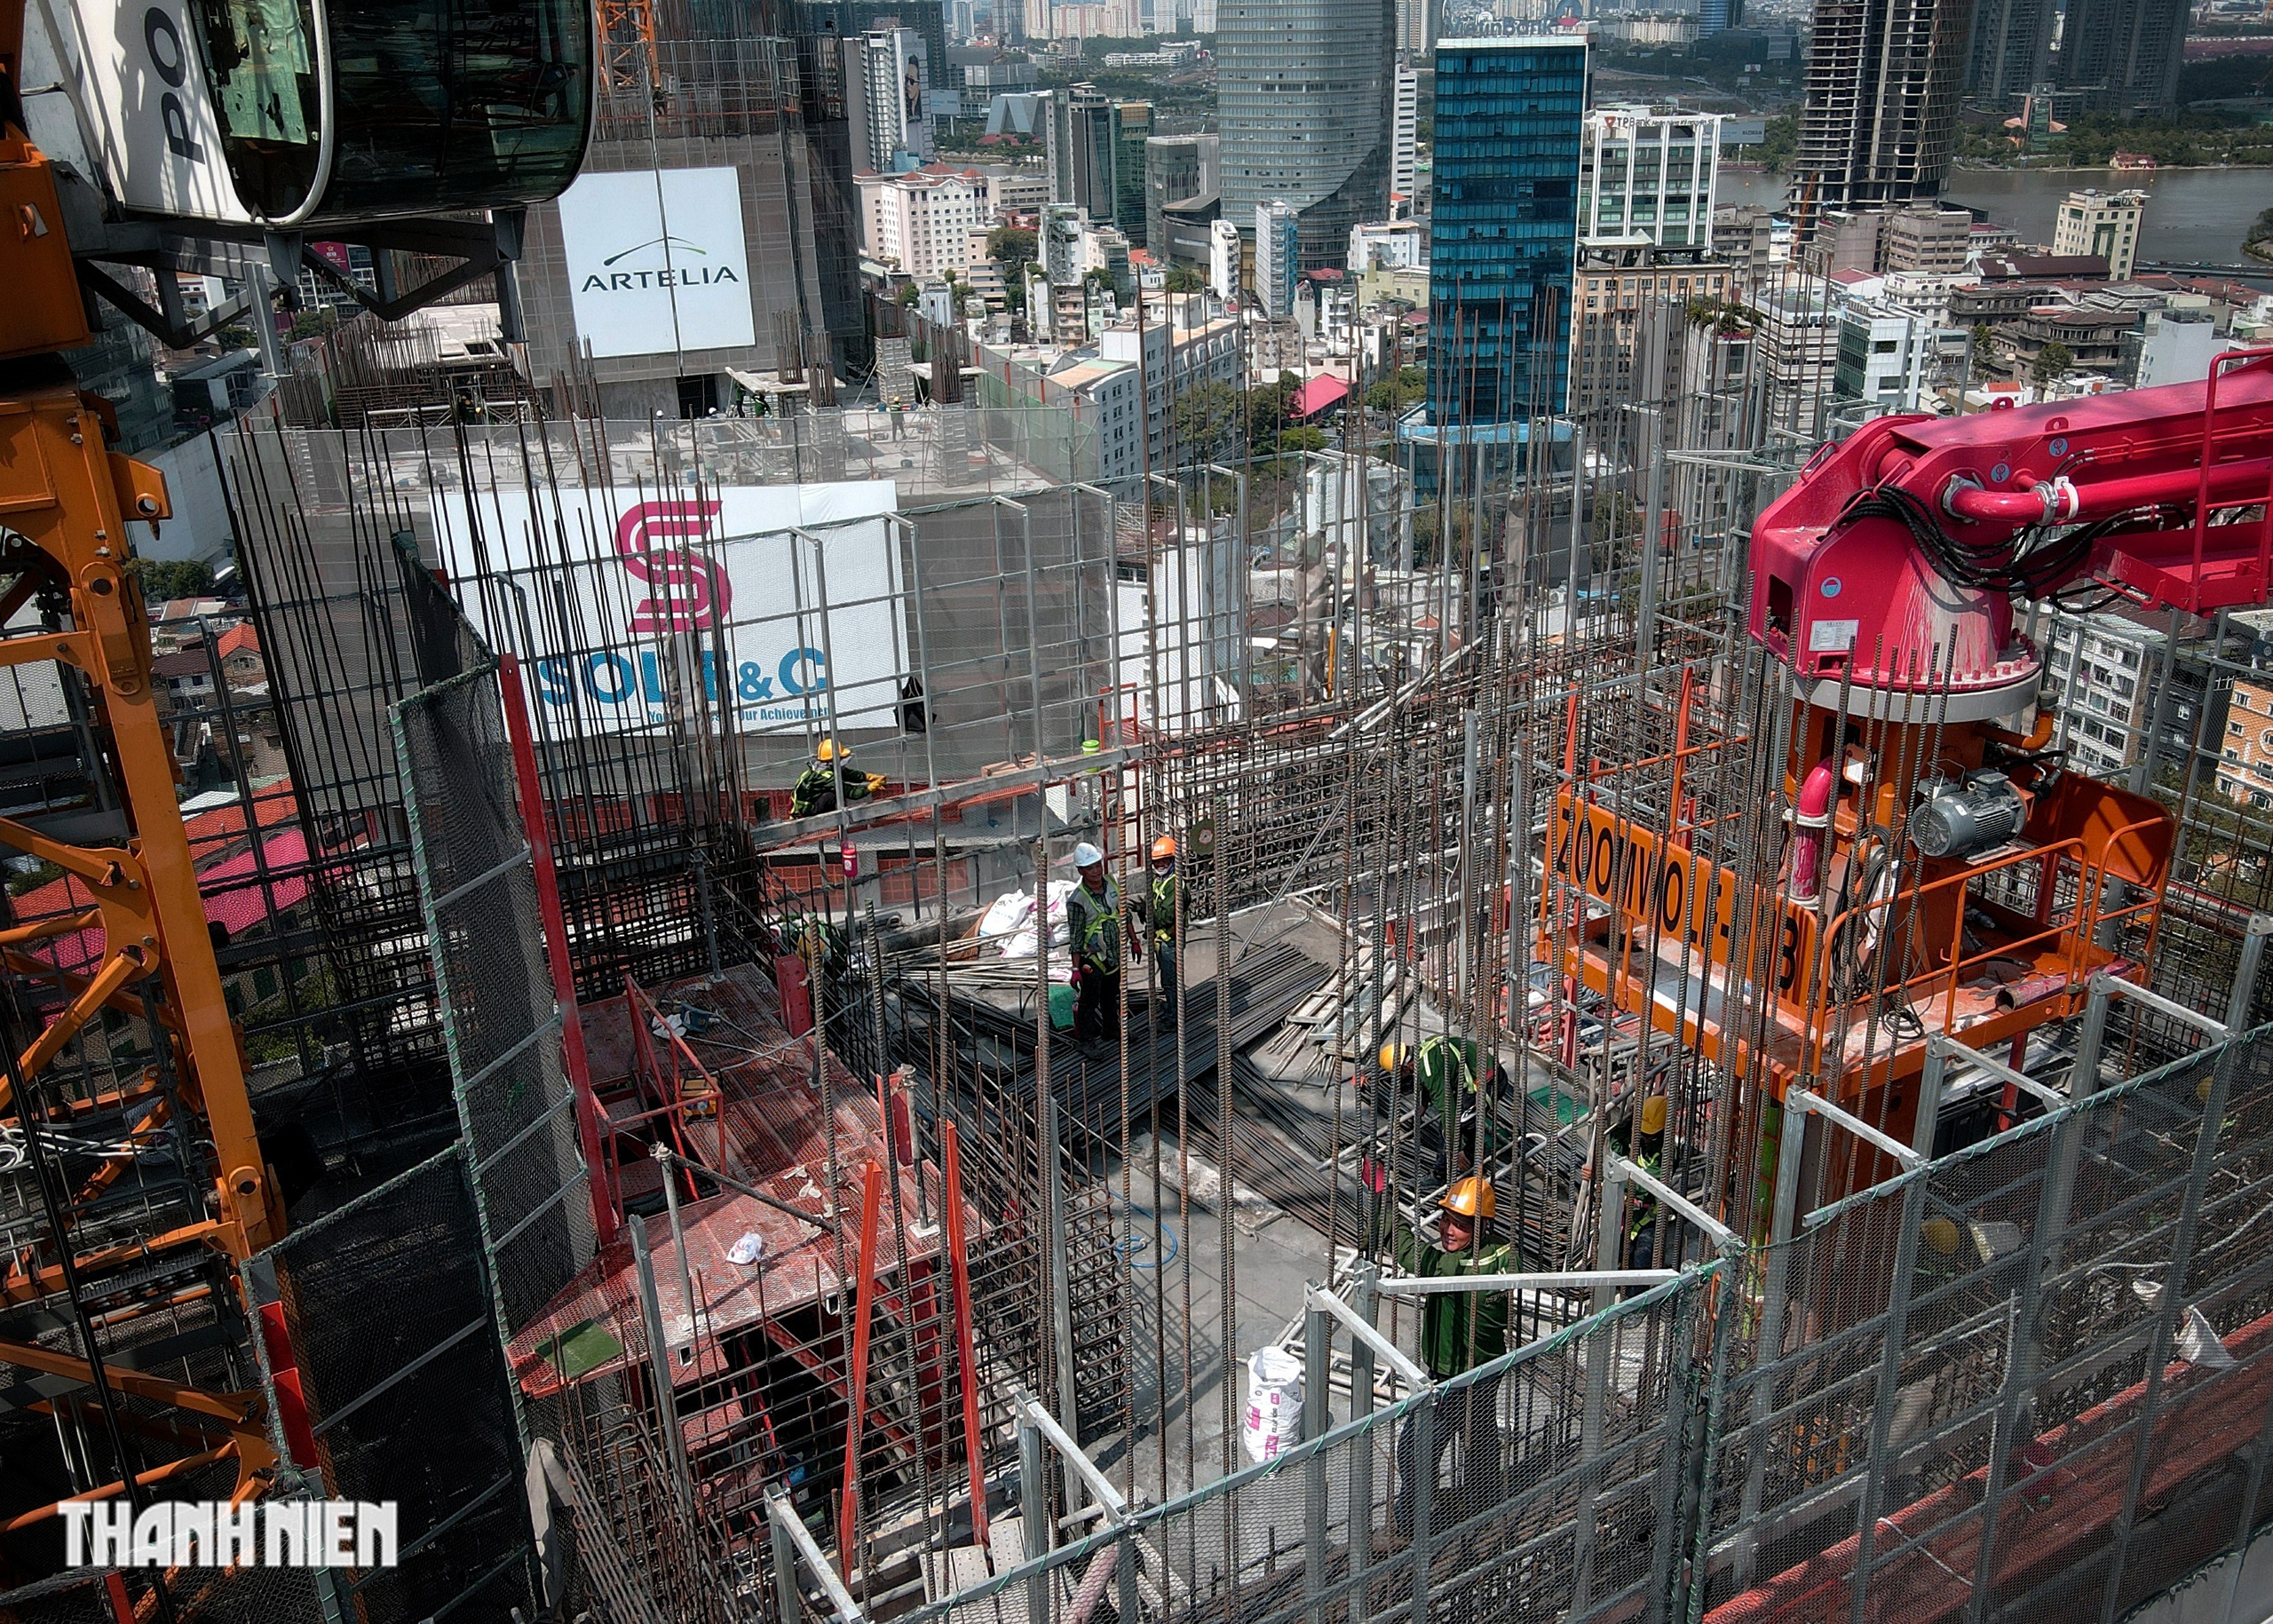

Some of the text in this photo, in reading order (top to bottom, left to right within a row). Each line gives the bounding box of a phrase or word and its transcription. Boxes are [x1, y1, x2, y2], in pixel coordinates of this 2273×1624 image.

[145, 7, 205, 164] PO
[1617, 116, 1651, 127] TPBank
[582, 265, 739, 293] ARTELIA
